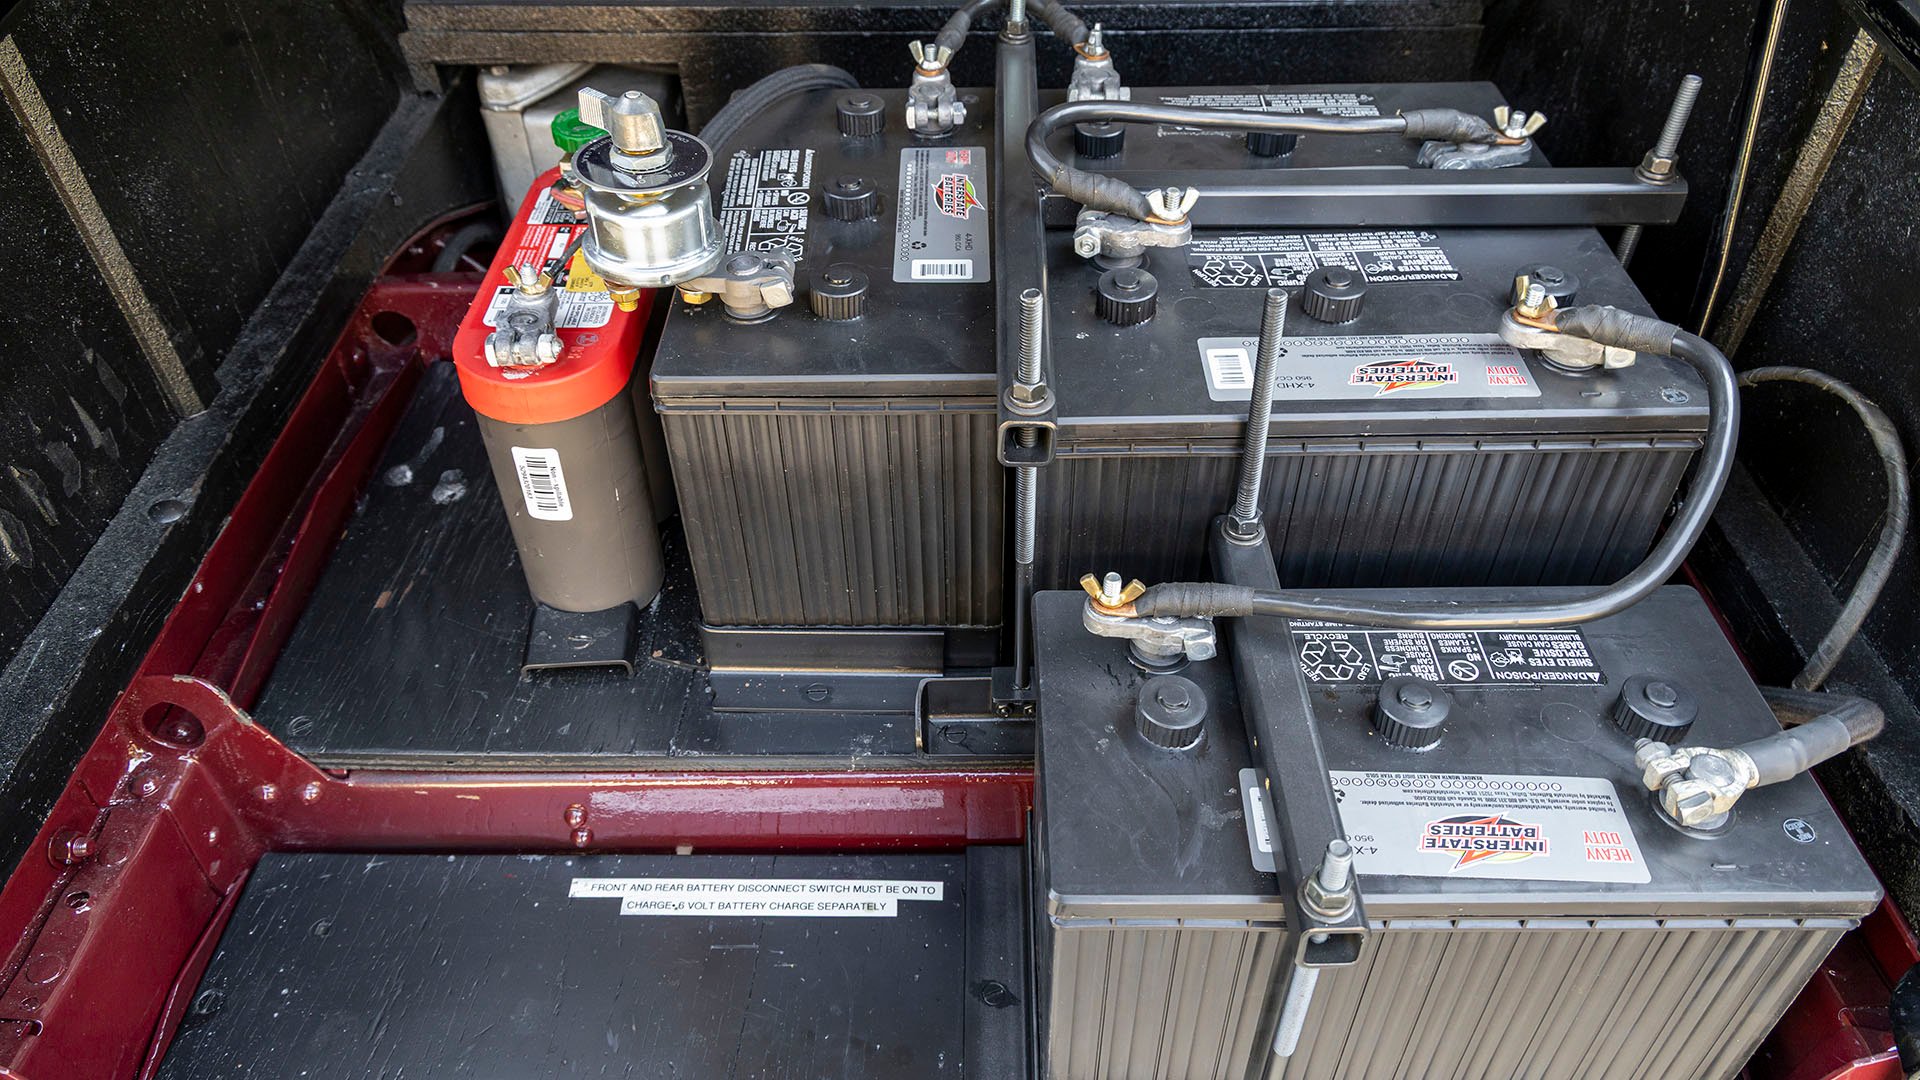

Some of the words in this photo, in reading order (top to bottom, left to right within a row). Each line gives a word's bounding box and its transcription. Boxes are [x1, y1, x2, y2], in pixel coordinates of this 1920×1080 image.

[944, 177, 953, 213] BATTERIES
[956, 176, 965, 216] INTERSTATE
[1192, 269, 1220, 287] RETURN
[1369, 274, 1447, 282] DANGER/POISON
[1359, 366, 1447, 374] BATTERIES
[1487, 366, 1519, 374] DUTY
[1355, 374, 1454, 382] INTERSTATE
[1489, 376, 1527, 384] HEAVY
[1551, 640, 1585, 649] GASES
[1466, 652, 1482, 661] NO
[1532, 648, 1588, 658] EXPLOSIVE
[1528, 658, 1556, 666] EYES
[1557, 658, 1594, 666] SHIELD
[1299, 662, 1321, 682] RETU
[1357, 663, 1372, 680] LEAD
[1410, 664, 1434, 672] ACID
[1496, 672, 1588, 680] DANGER/POISON
[1430, 825, 1536, 838] BATTERIES
[1584, 832, 1622, 845] DUTY
[1425, 838, 1544, 851] INTERSTATE
[1353, 846, 1378, 854] 4-X
[1586, 848, 1632, 862] HEAVY
[590, 884, 628, 892] FRONT
[630, 884, 653, 892] AND
[655, 884, 684, 892] REAR
[686, 884, 734, 892] BATTERY
[738, 884, 806, 892] DISCONNECT
[808, 884, 850, 893] SWITCH
[852, 885, 882, 893] MUST
[886, 886, 900, 894] BE
[902, 886, 918, 894] ON
[922, 886, 936, 894] TO
[718, 902, 766, 910] BATTERY
[769, 902, 814, 910] CHARGE
[816, 902, 887, 910] SEPARATELY
